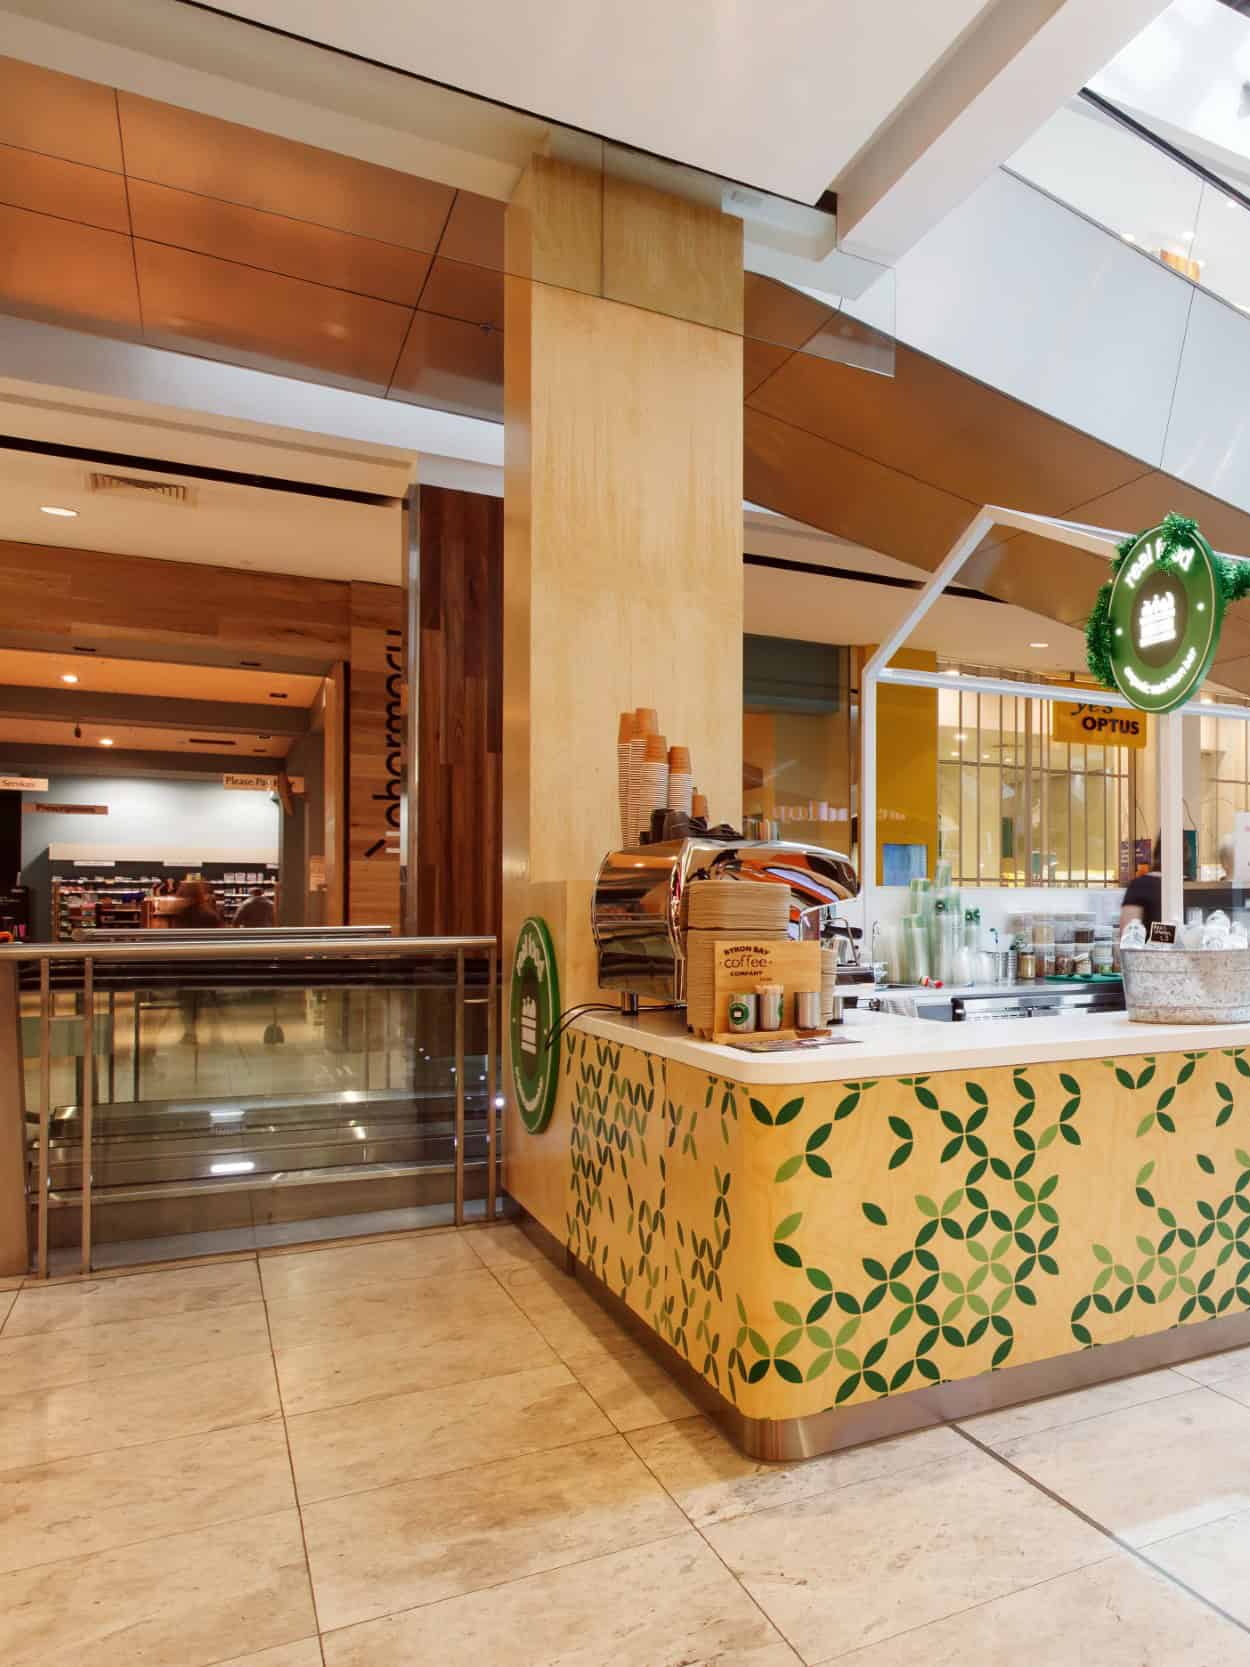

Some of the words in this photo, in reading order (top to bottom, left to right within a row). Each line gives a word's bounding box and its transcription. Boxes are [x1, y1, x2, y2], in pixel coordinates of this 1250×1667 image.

[1125, 542, 1154, 589] real
[1155, 536, 1195, 572] fd
[1082, 716, 1139, 735] OPTUS
[724, 954, 768, 969] coffee
